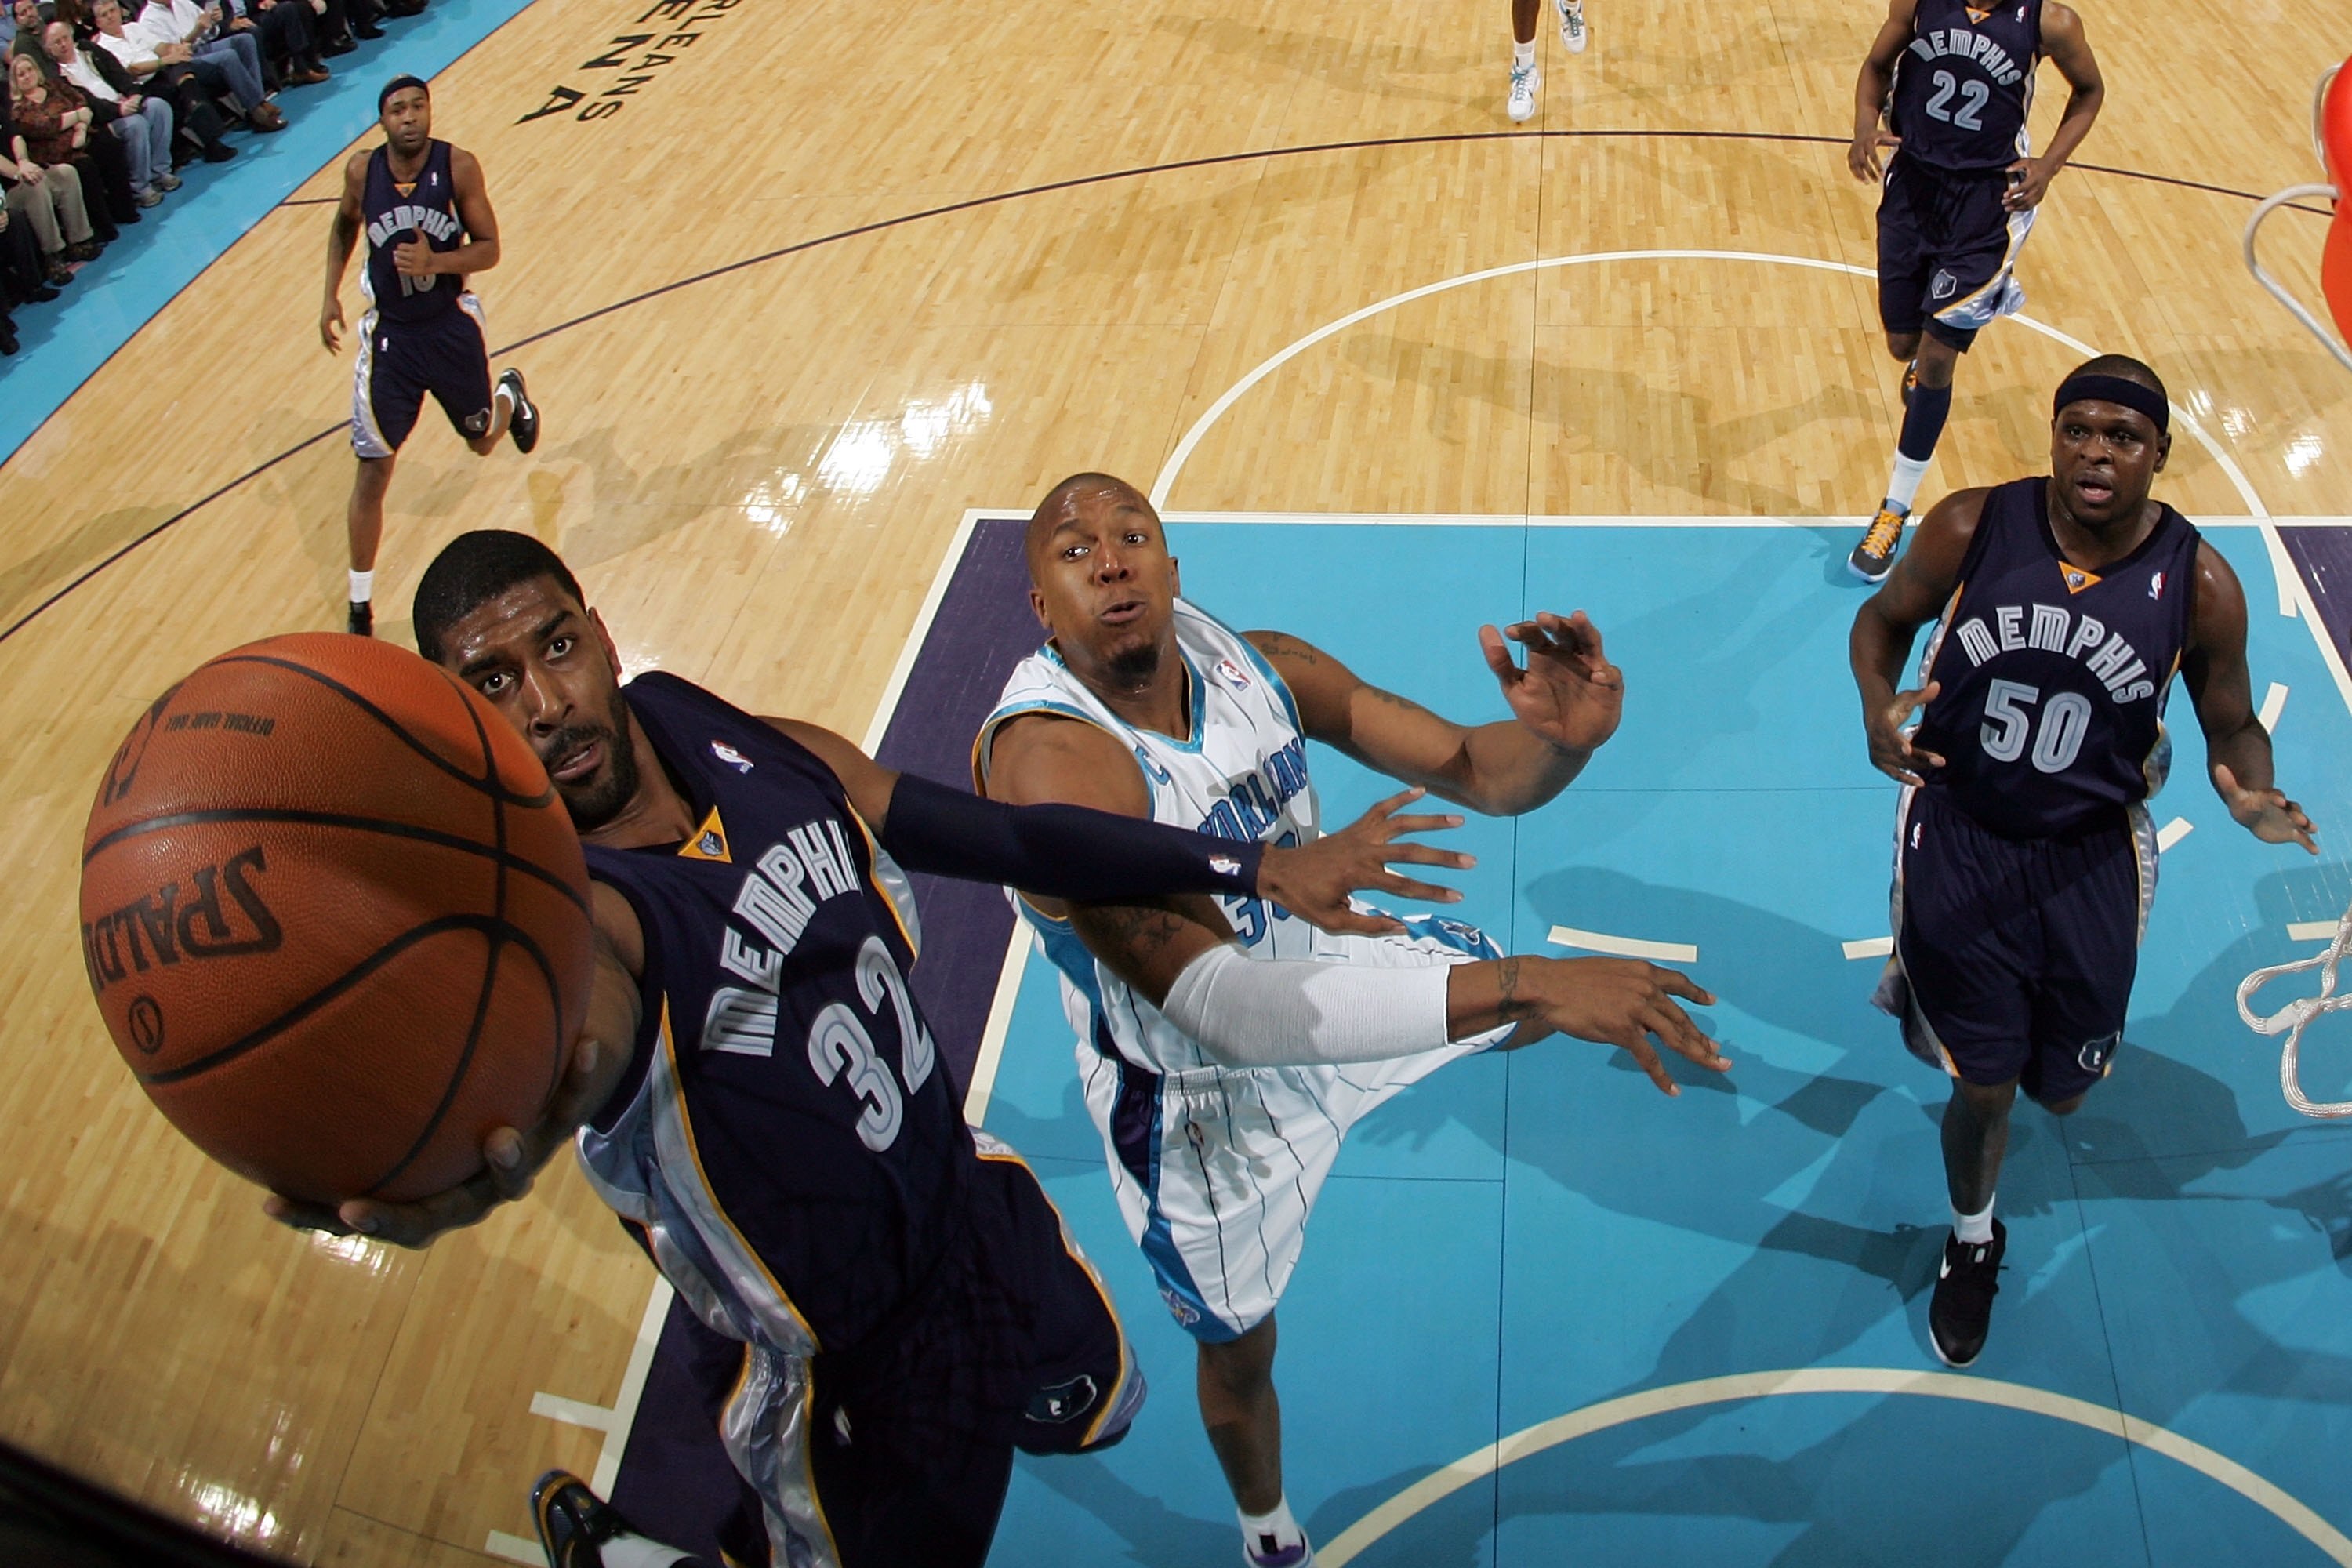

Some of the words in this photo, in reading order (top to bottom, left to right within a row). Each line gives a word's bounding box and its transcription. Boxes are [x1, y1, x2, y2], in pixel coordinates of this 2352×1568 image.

[1909, 28, 2022, 85] MEMPHIS
[1926, 69, 1989, 131] 22
[368, 205, 456, 248] MEMPHIS
[1956, 603, 2154, 704] MEMPHIS
[1980, 678, 2092, 774] 50
[82, 846, 283, 992] SPALDI
[700, 819, 864, 1057] MEMPHI
[808, 935, 935, 1152] 32
